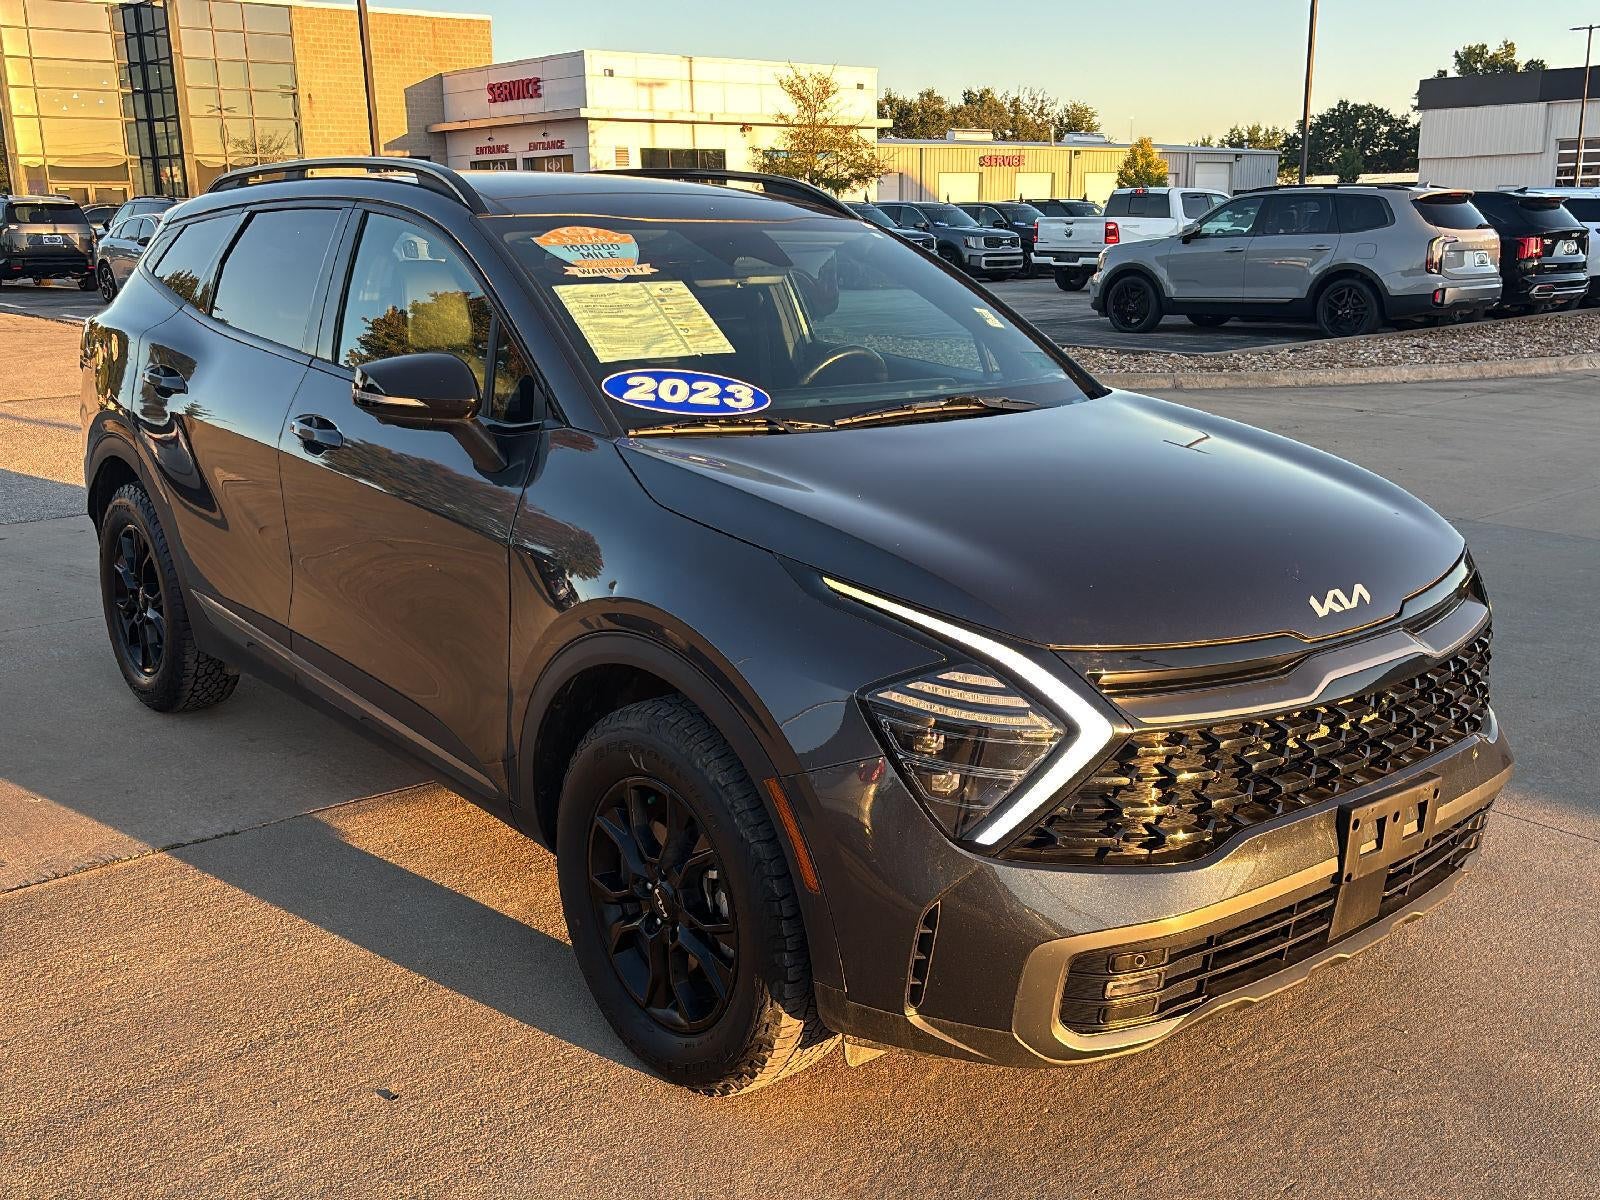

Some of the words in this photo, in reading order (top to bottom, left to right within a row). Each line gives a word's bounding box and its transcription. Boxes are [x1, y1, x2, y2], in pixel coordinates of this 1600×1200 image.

[487, 77, 542, 103] SERVICE
[475, 144, 510, 155] ENTRANCE
[528, 140, 565, 151] ENTRANCE
[979, 155, 1025, 167] SERVICE
[580, 251, 619, 259] MILE
[577, 266, 645, 276] WARRANTY
[623, 376, 754, 409] 2023
[1309, 583, 1371, 618] KIA
